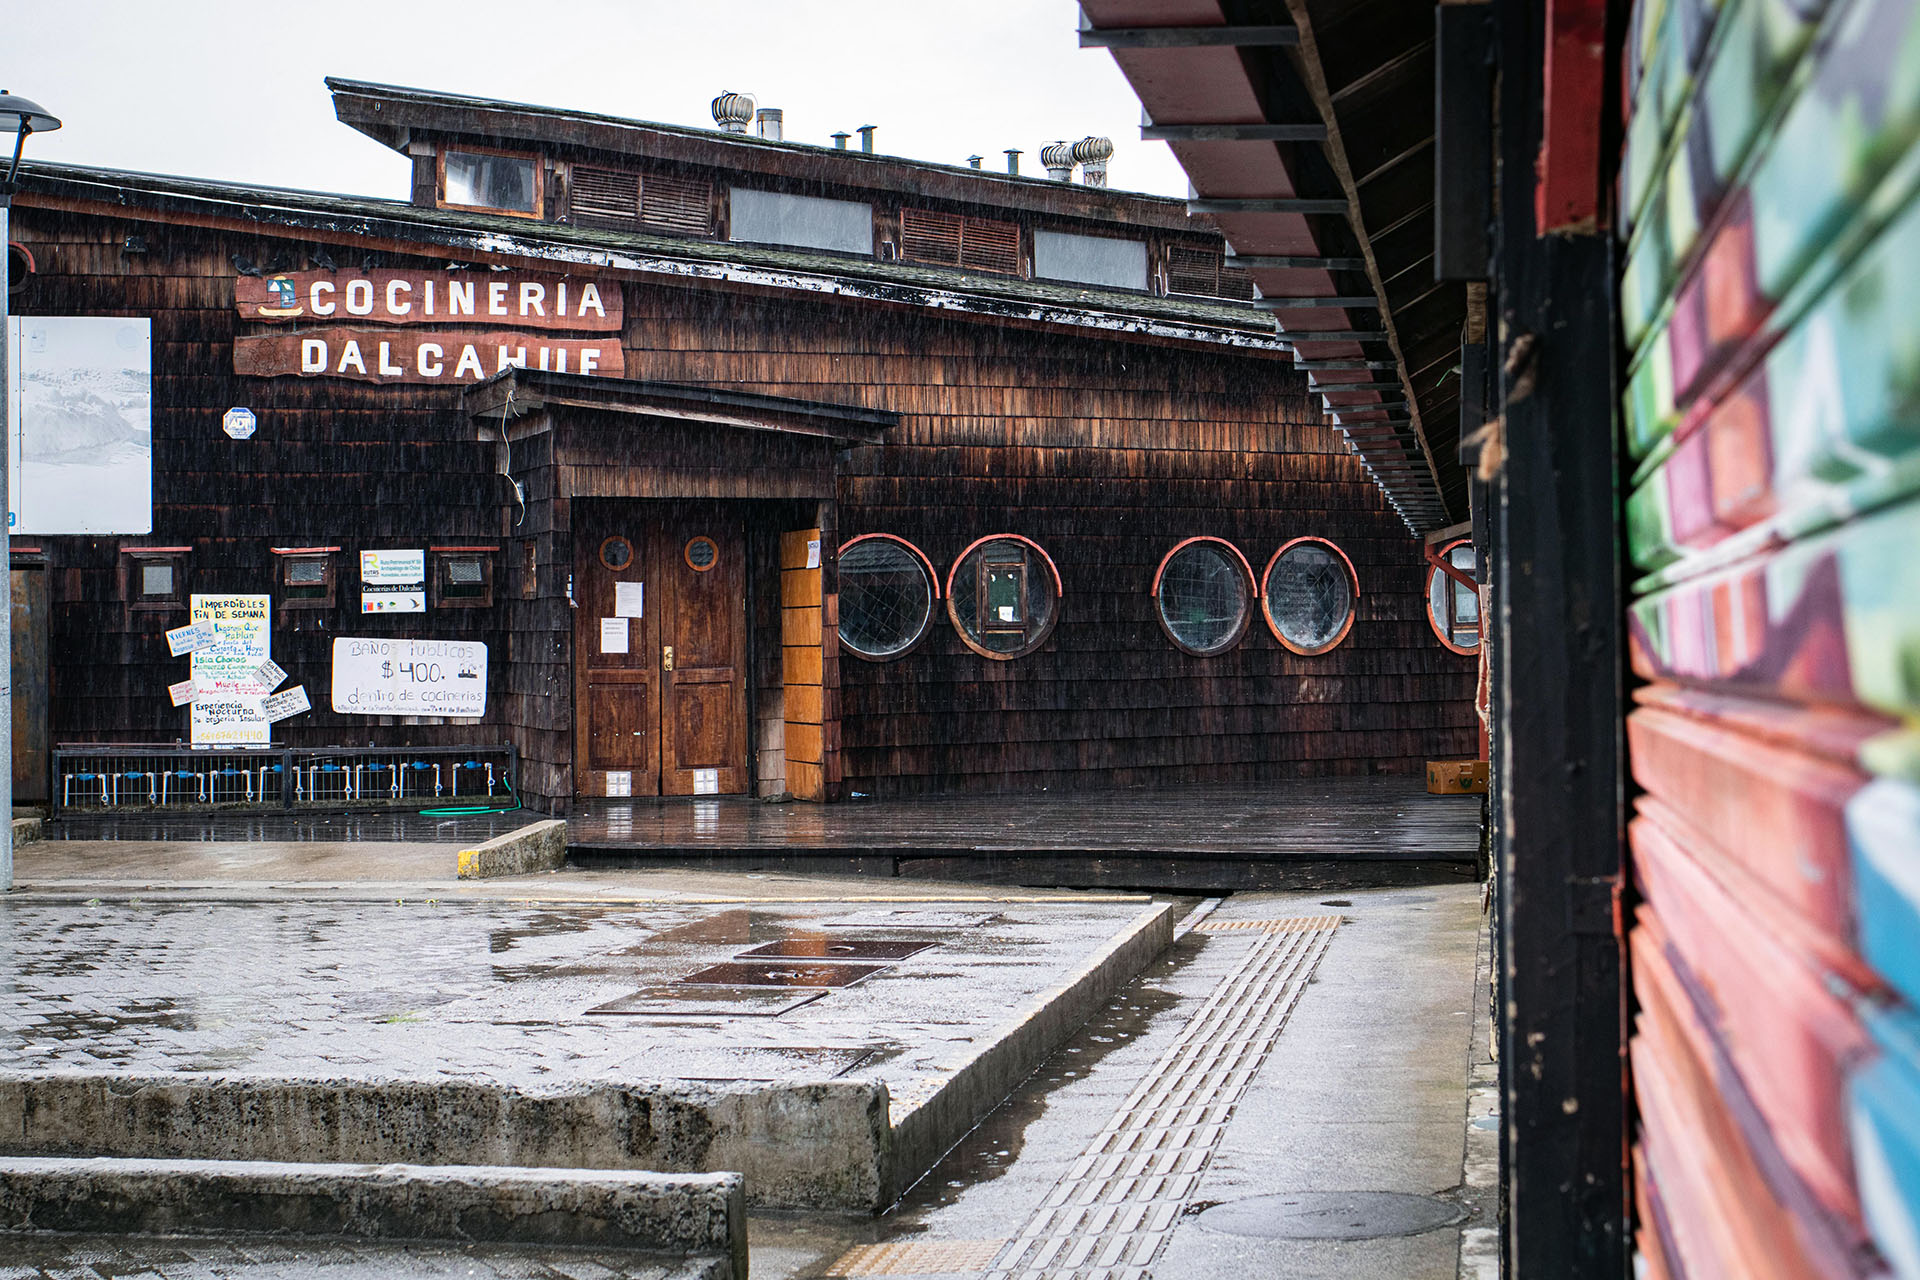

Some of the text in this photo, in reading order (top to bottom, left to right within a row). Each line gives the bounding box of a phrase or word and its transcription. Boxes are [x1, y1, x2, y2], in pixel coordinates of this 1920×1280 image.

[301, 339, 601, 380] DALCAHUE
[227, 417, 251, 431] ADT
[215, 610, 227, 619] DE
[231, 610, 265, 619] SEMANA
[398, 689, 414, 701] de
